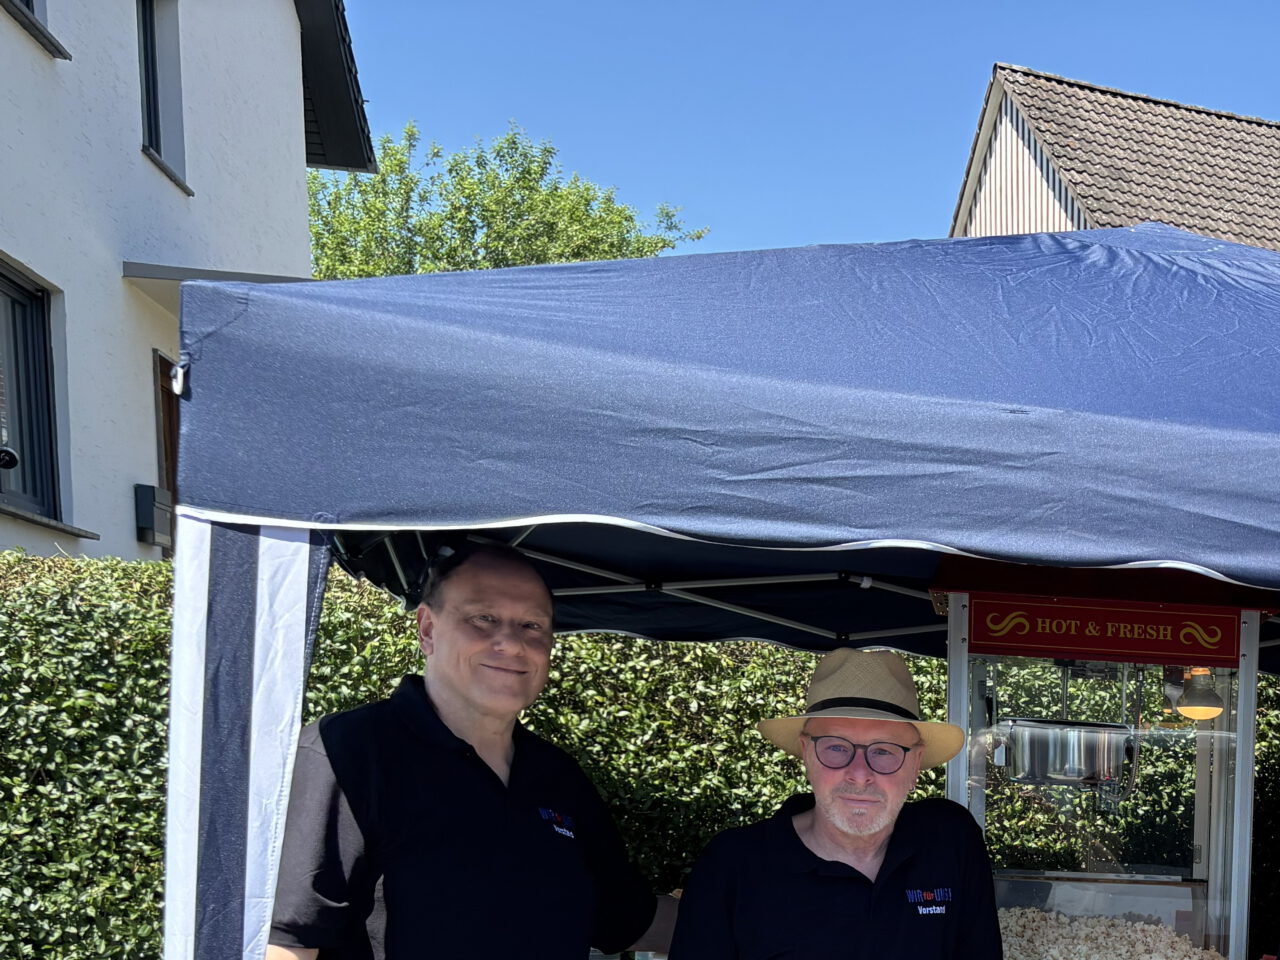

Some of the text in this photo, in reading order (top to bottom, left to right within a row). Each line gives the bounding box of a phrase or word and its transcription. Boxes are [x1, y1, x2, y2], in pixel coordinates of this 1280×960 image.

[1036, 618, 1173, 640] HOT & FRESH
